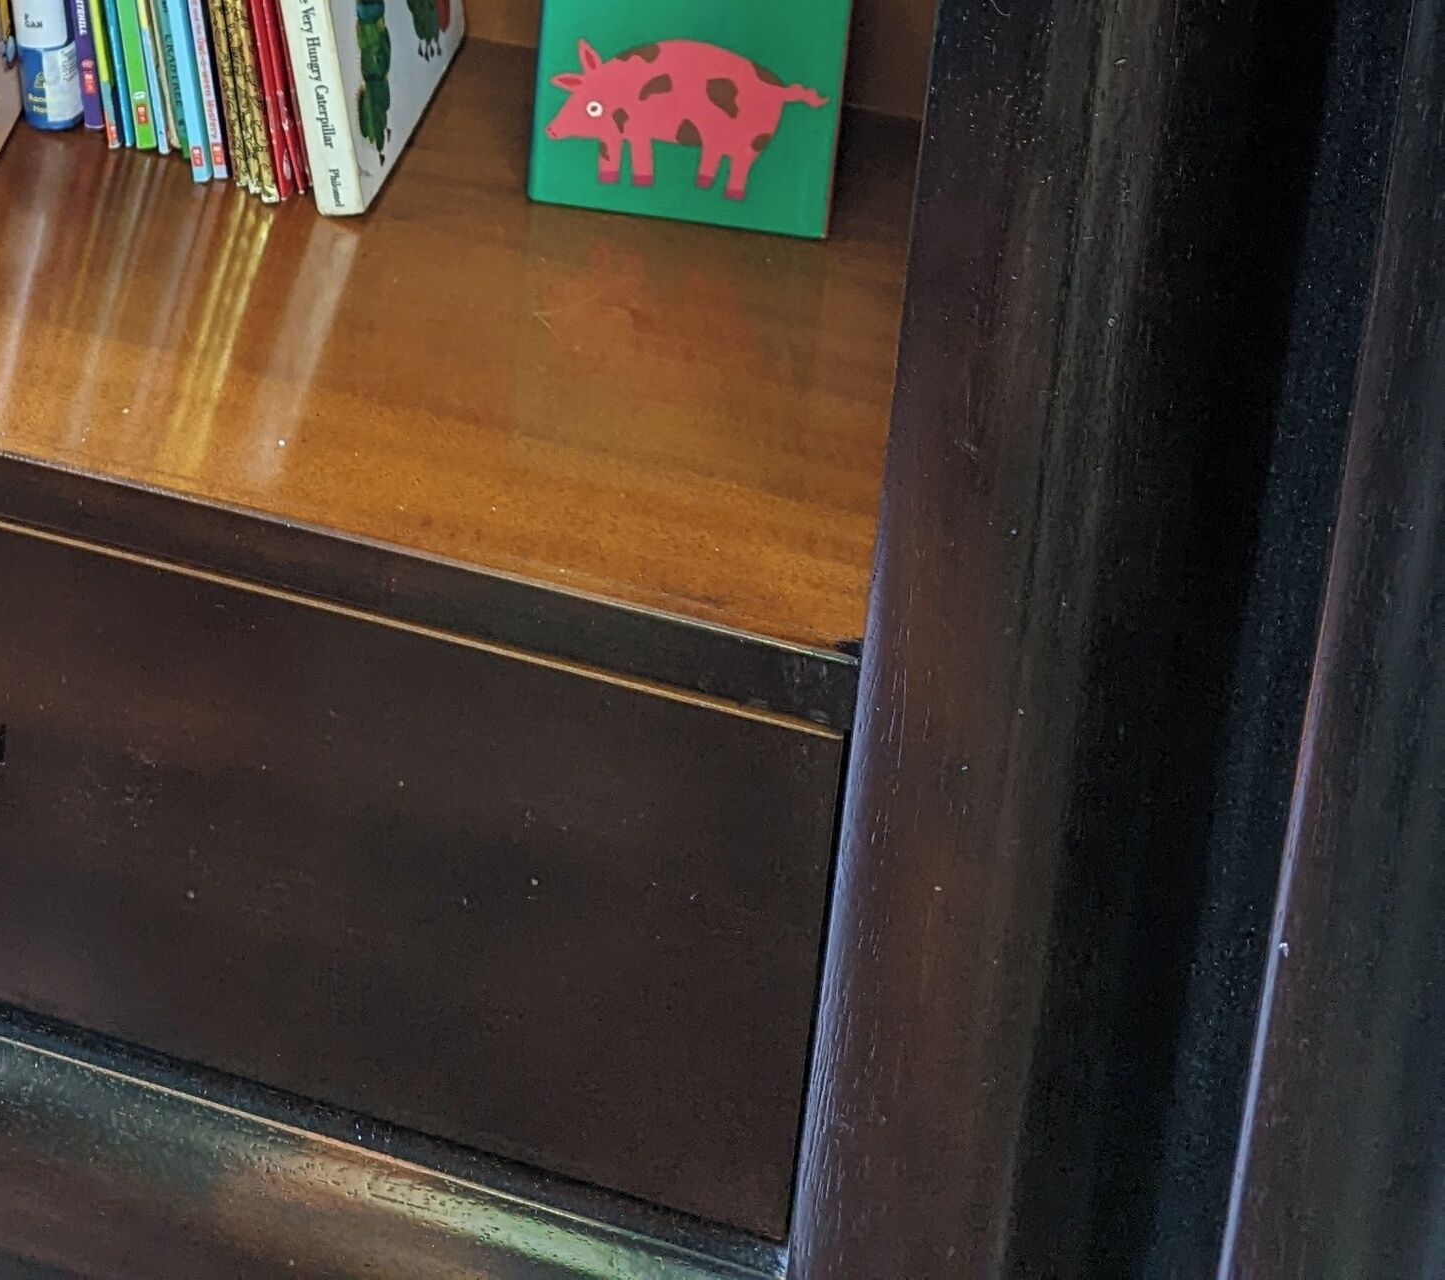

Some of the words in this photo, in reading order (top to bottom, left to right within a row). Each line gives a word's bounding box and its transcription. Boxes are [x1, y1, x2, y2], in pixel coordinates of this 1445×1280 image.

[300, 5, 317, 34] Very
[306, 36, 324, 82] Hungry
[314, 84, 336, 149] Caterpillar
[329, 168, 345, 207] Philomel
